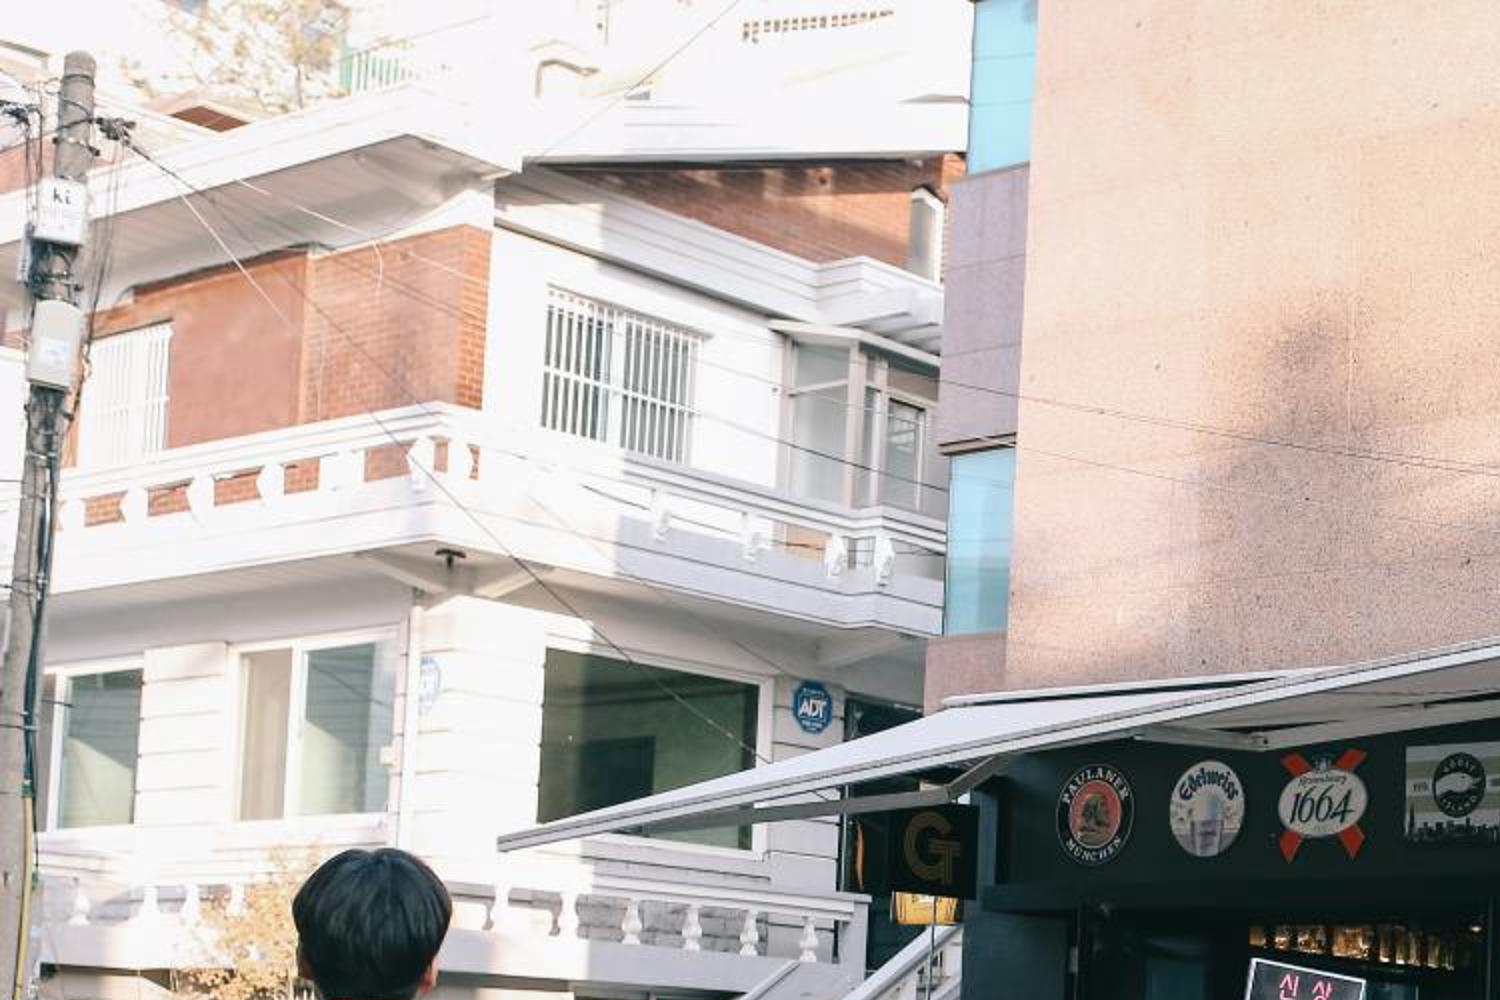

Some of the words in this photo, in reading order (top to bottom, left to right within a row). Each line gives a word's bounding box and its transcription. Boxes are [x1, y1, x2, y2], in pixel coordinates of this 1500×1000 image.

[799, 699, 827, 718] ADT
[1062, 767, 1129, 804] PAULANER
[1289, 784, 1355, 824] 1664
